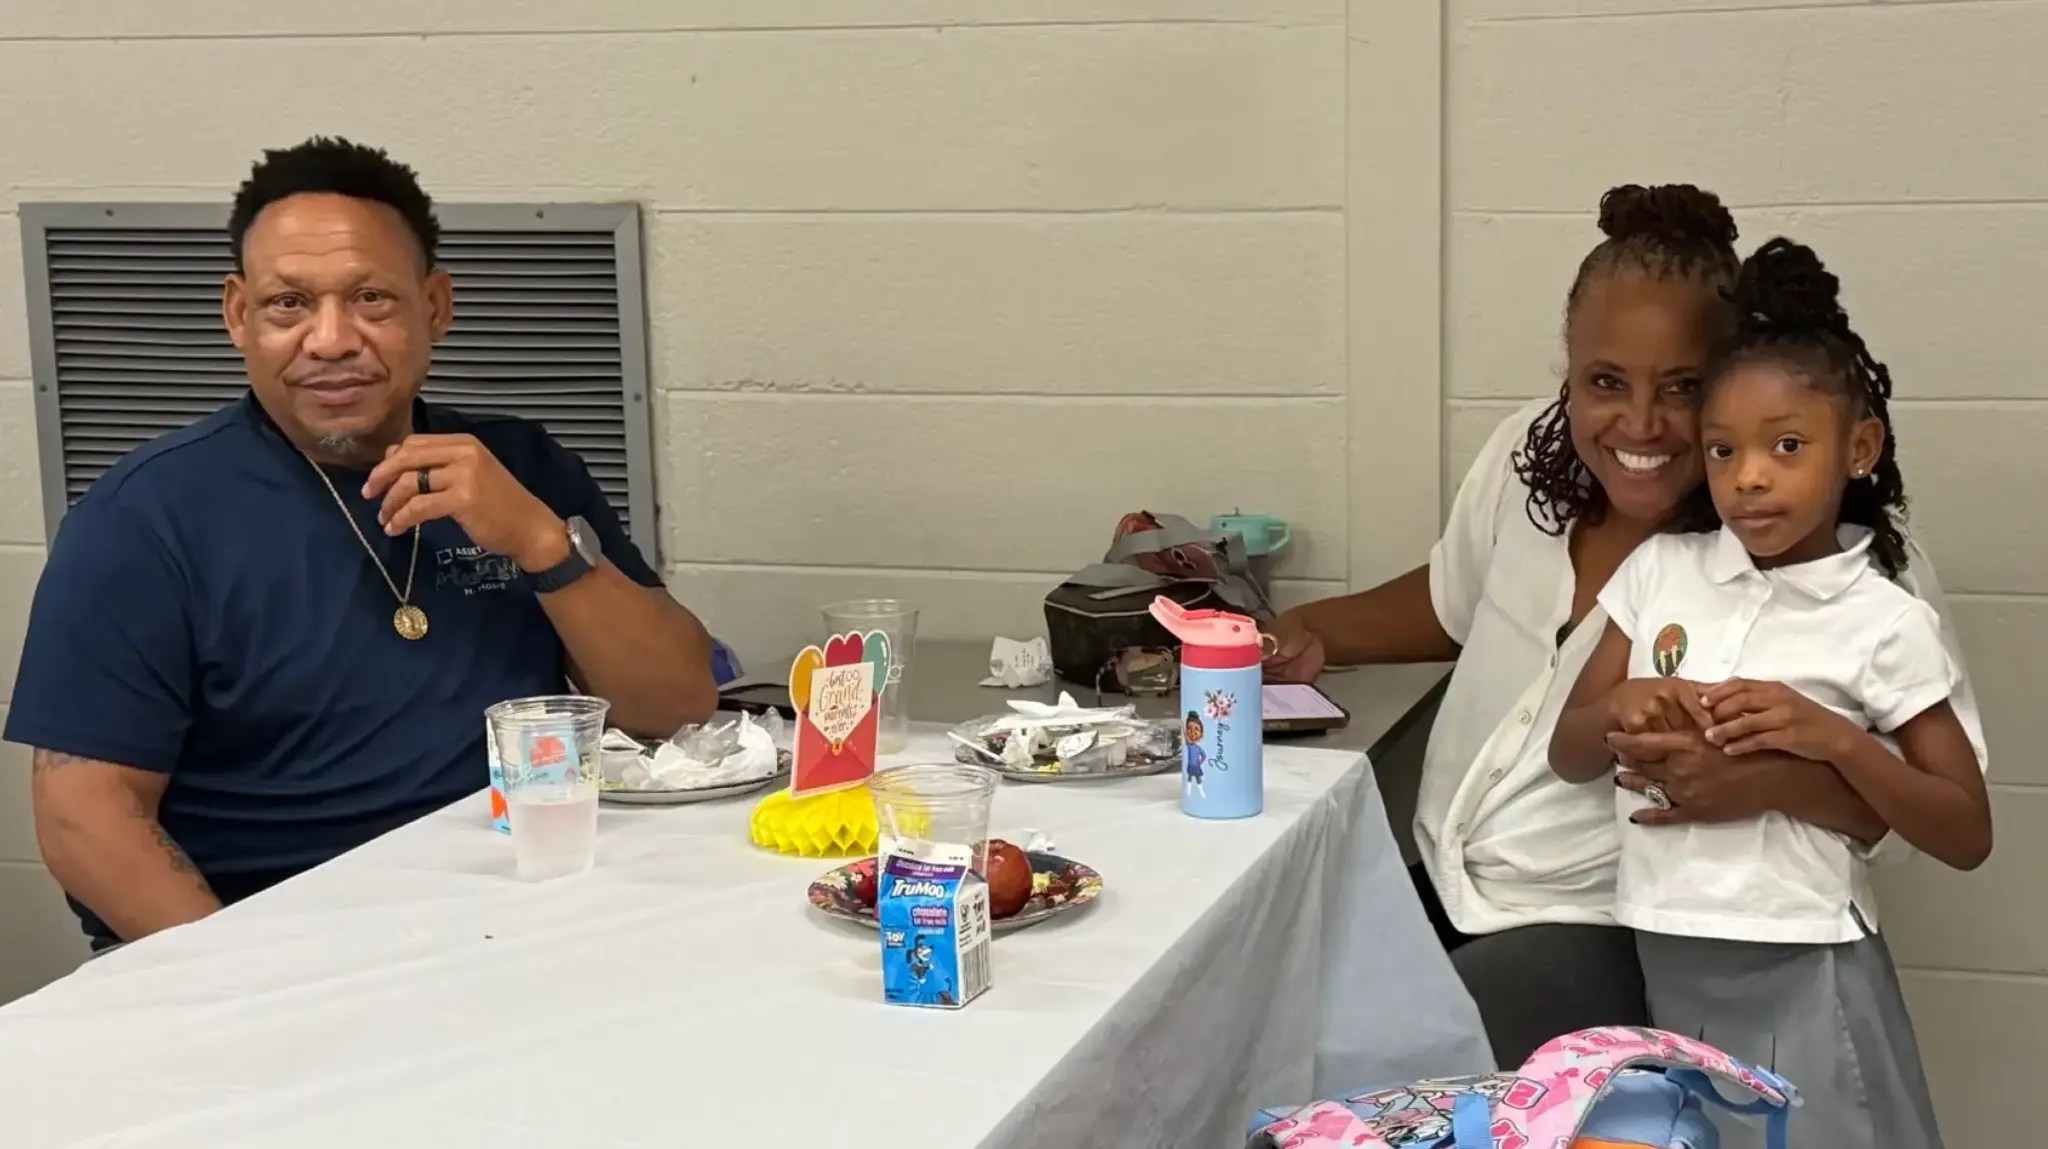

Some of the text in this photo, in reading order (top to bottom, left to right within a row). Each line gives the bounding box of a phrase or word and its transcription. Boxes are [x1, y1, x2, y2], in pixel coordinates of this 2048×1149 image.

[819, 677, 862, 712] Grand
[1208, 721, 1230, 771] Journey
[891, 879, 945, 899] TruMoo
